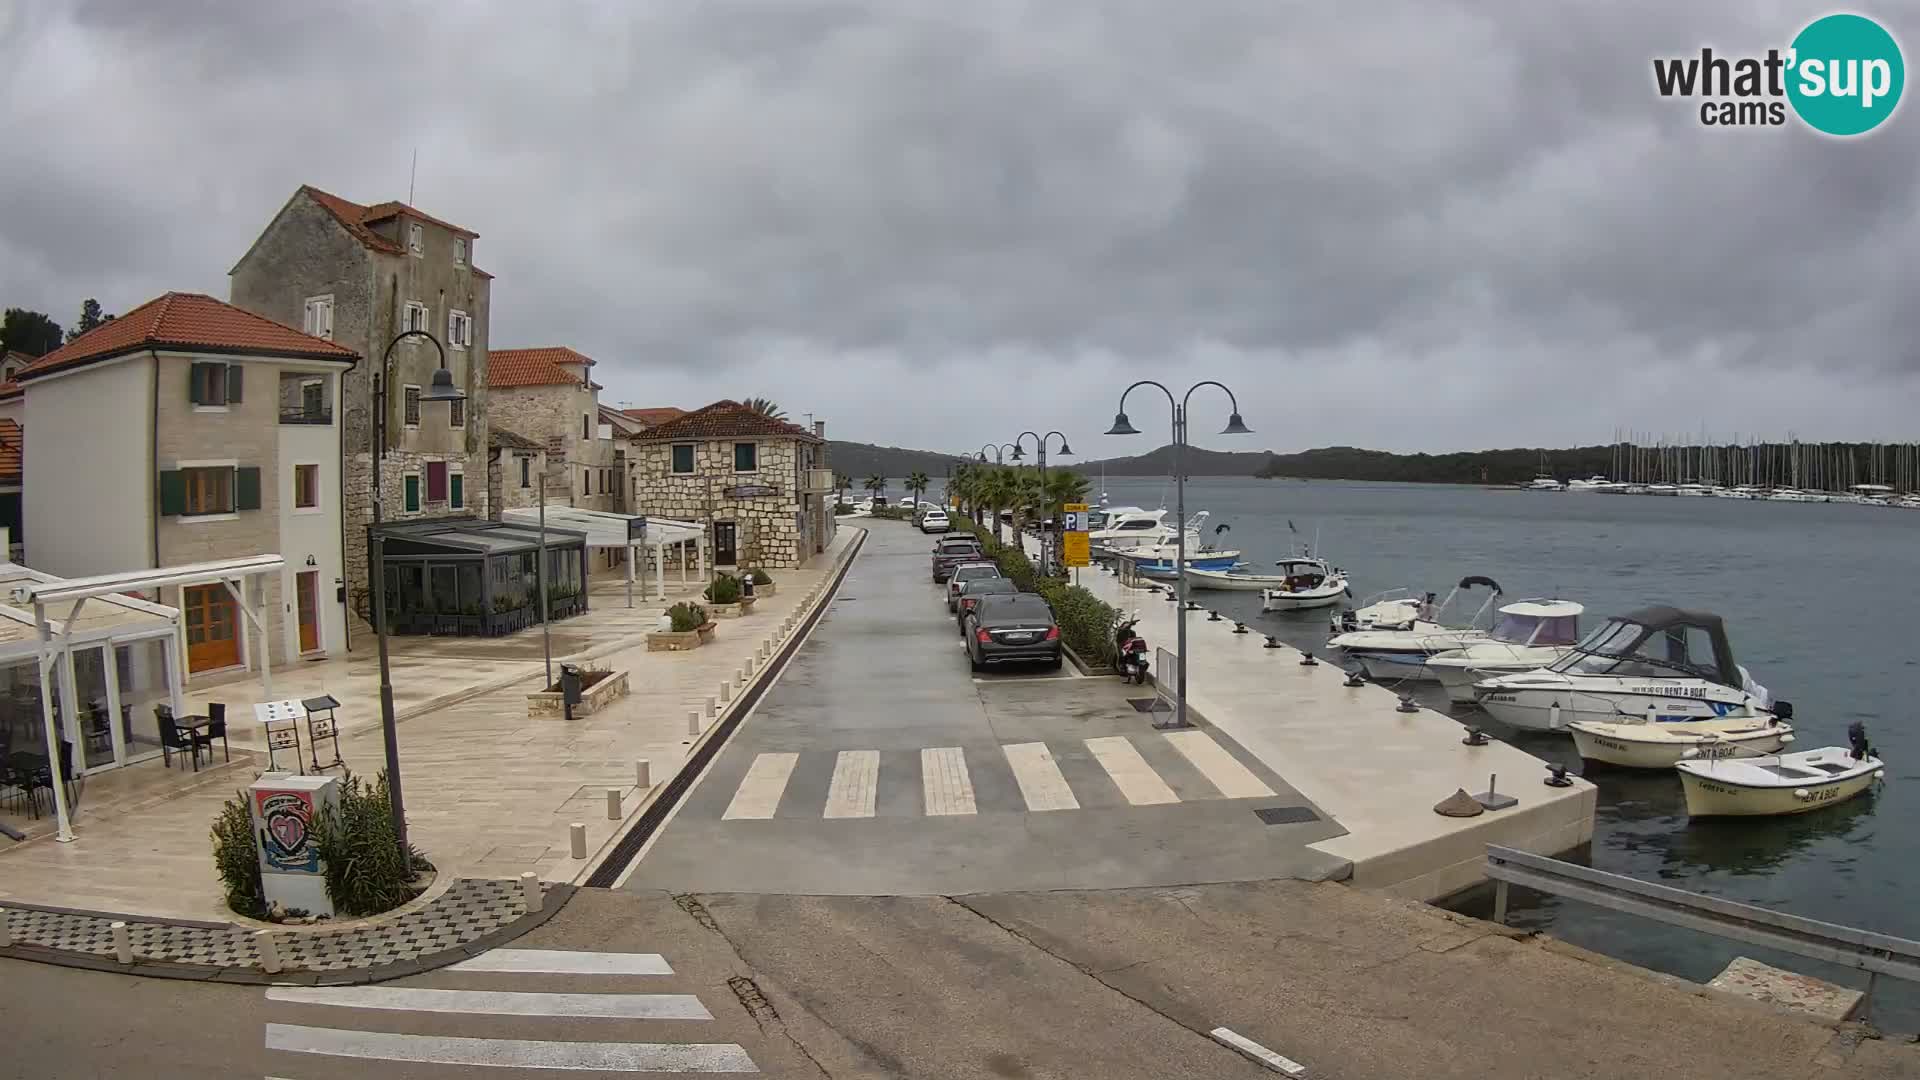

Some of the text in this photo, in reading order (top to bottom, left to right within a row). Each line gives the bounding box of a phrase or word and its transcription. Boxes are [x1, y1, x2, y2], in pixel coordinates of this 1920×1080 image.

[1664, 686, 1683, 696] RENT
[1683, 687, 1689, 696] A
[1690, 687, 1707, 697] BOAT
[1719, 746, 1737, 758] BOAT
[1825, 787, 1840, 799] BOAT
